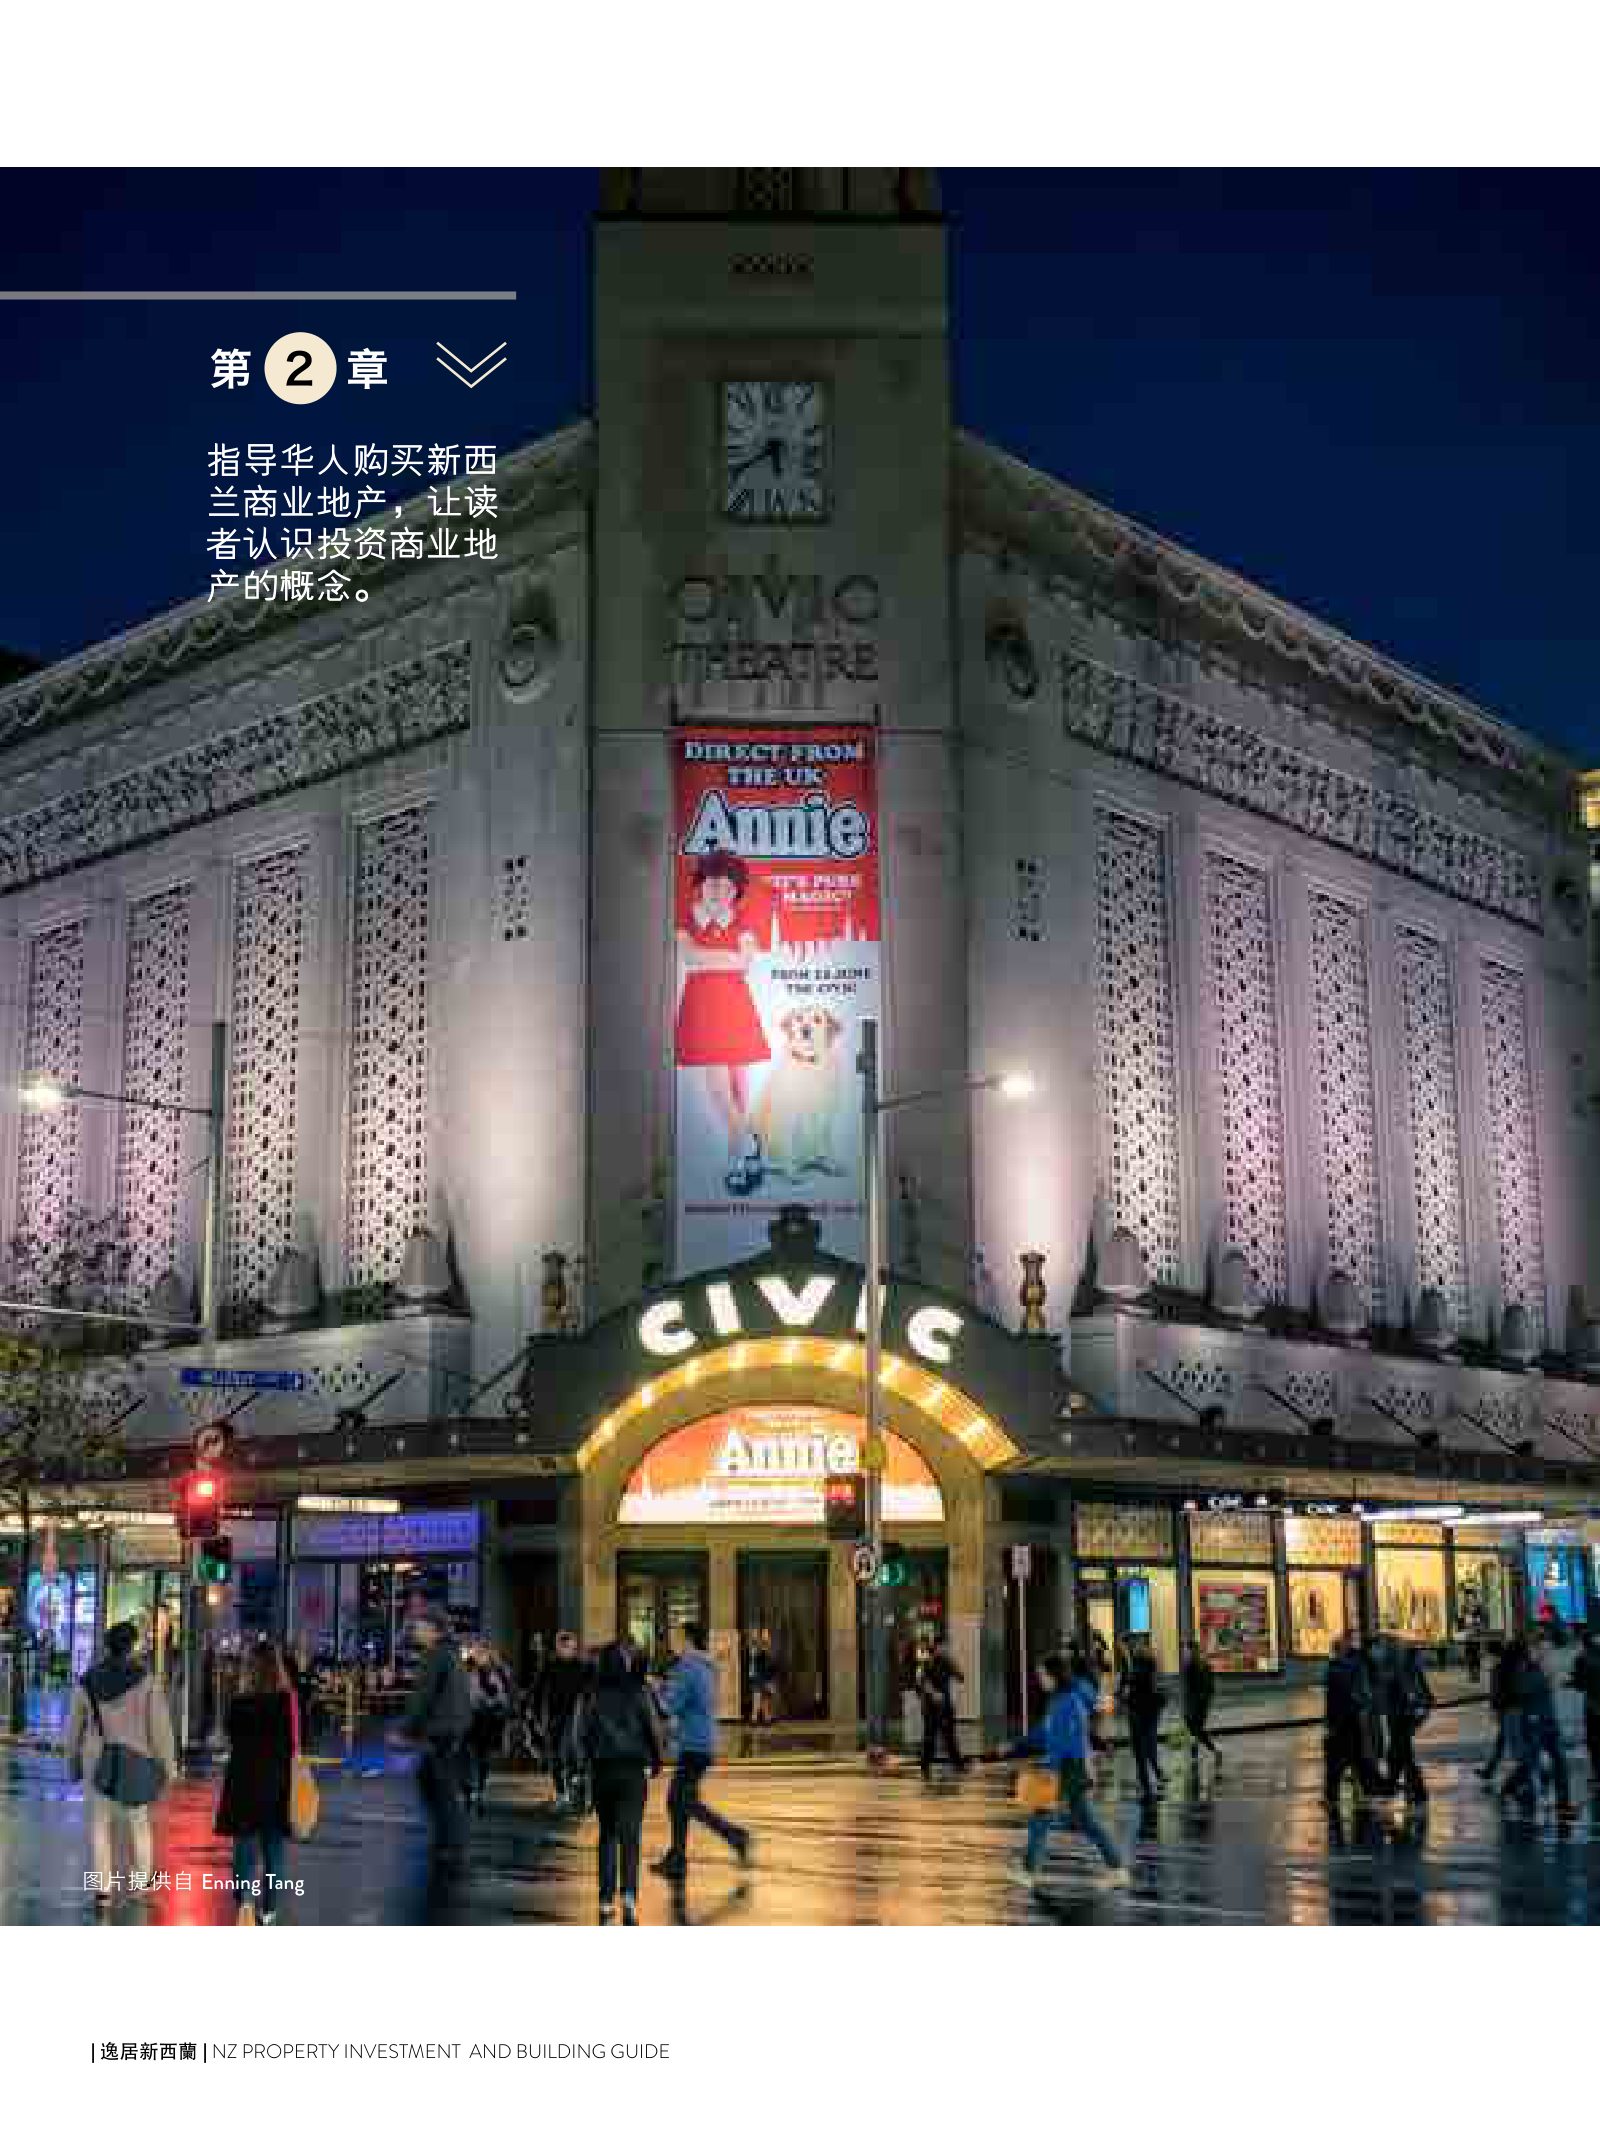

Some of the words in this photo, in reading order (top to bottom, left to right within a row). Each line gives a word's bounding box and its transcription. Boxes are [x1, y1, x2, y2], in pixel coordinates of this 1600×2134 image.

[666, 643, 879, 682] THEATRE
[685, 741, 780, 761] DIRECT
[790, 741, 865, 761] FROM
[727, 768, 778, 787] THE
[683, 790, 868, 857] Annie
[639, 1274, 966, 1364] CIVIC
[714, 1425, 859, 1476] Annie
